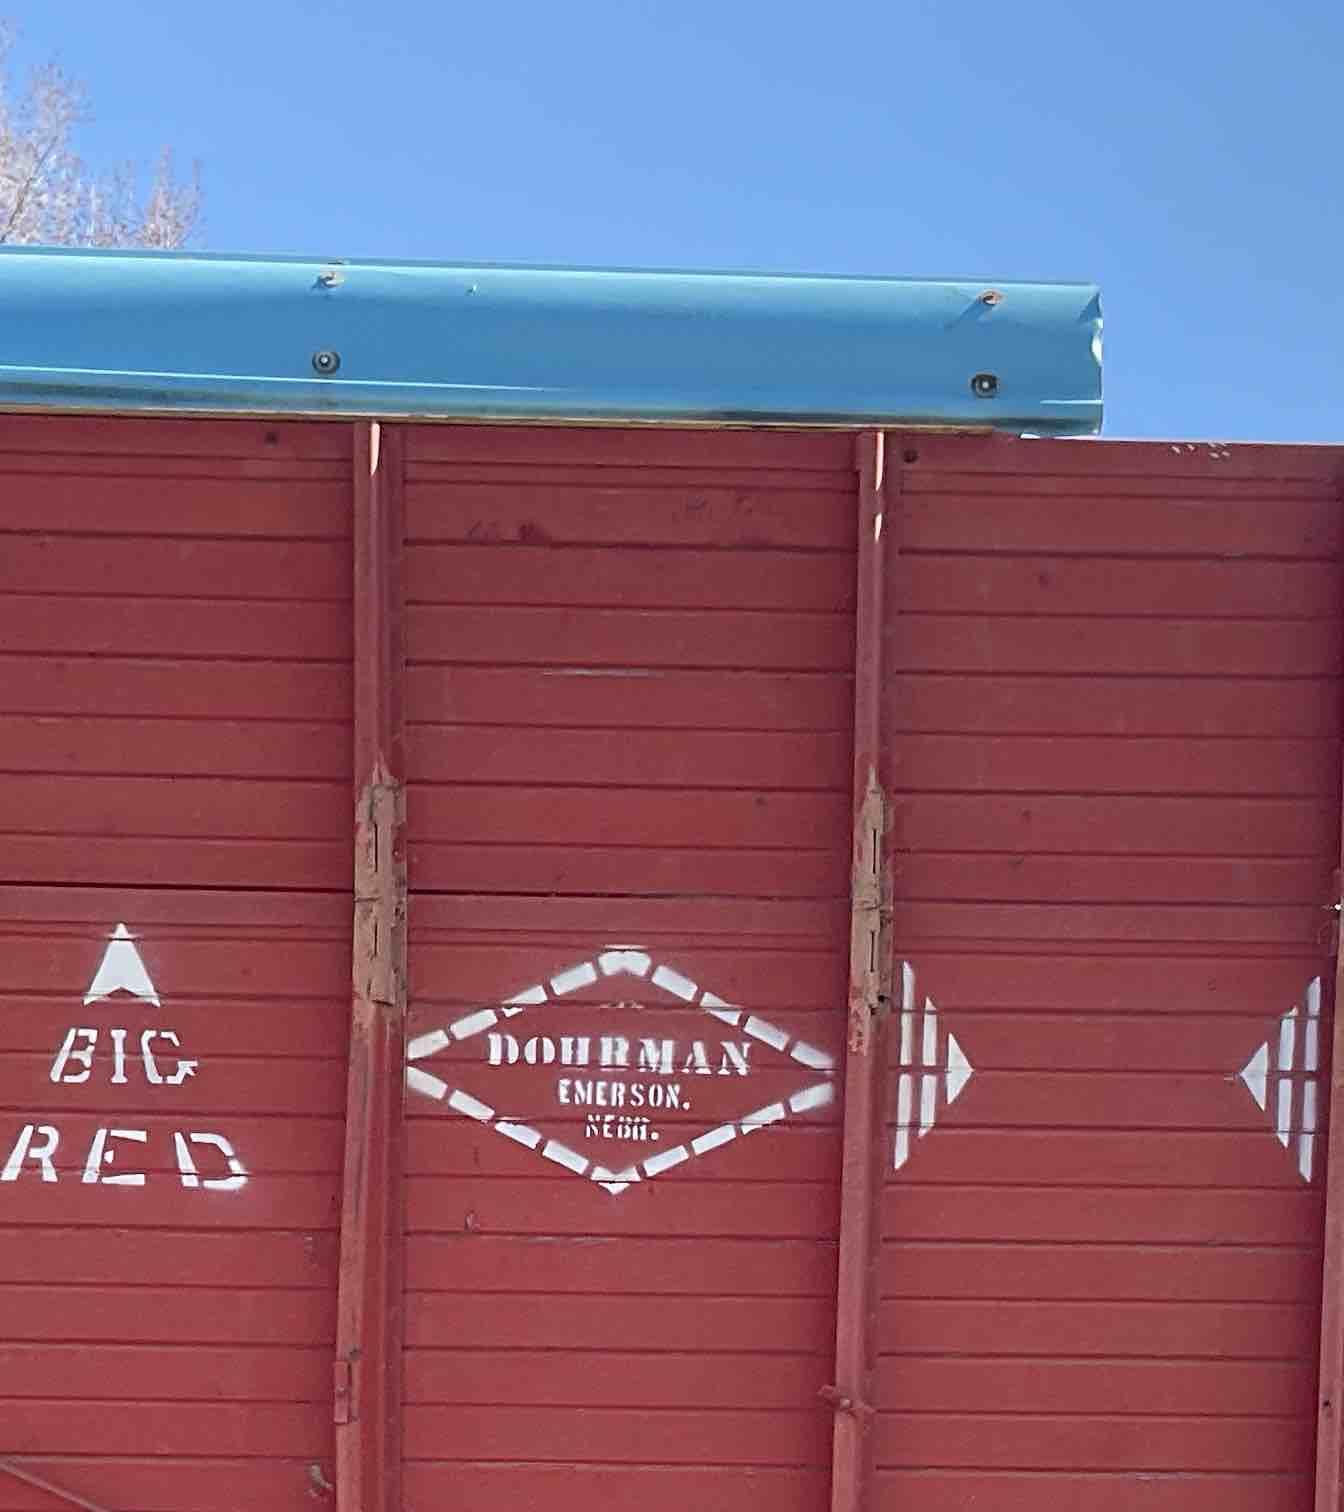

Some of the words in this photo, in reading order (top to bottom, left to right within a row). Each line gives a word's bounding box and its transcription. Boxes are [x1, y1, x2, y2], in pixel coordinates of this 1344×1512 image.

[49, 1027, 199, 1085] BIG
[487, 1032, 752, 1076] DOHRMAN
[559, 1078, 691, 1110] EMERSON.
[0, 1124, 249, 1190] RED
